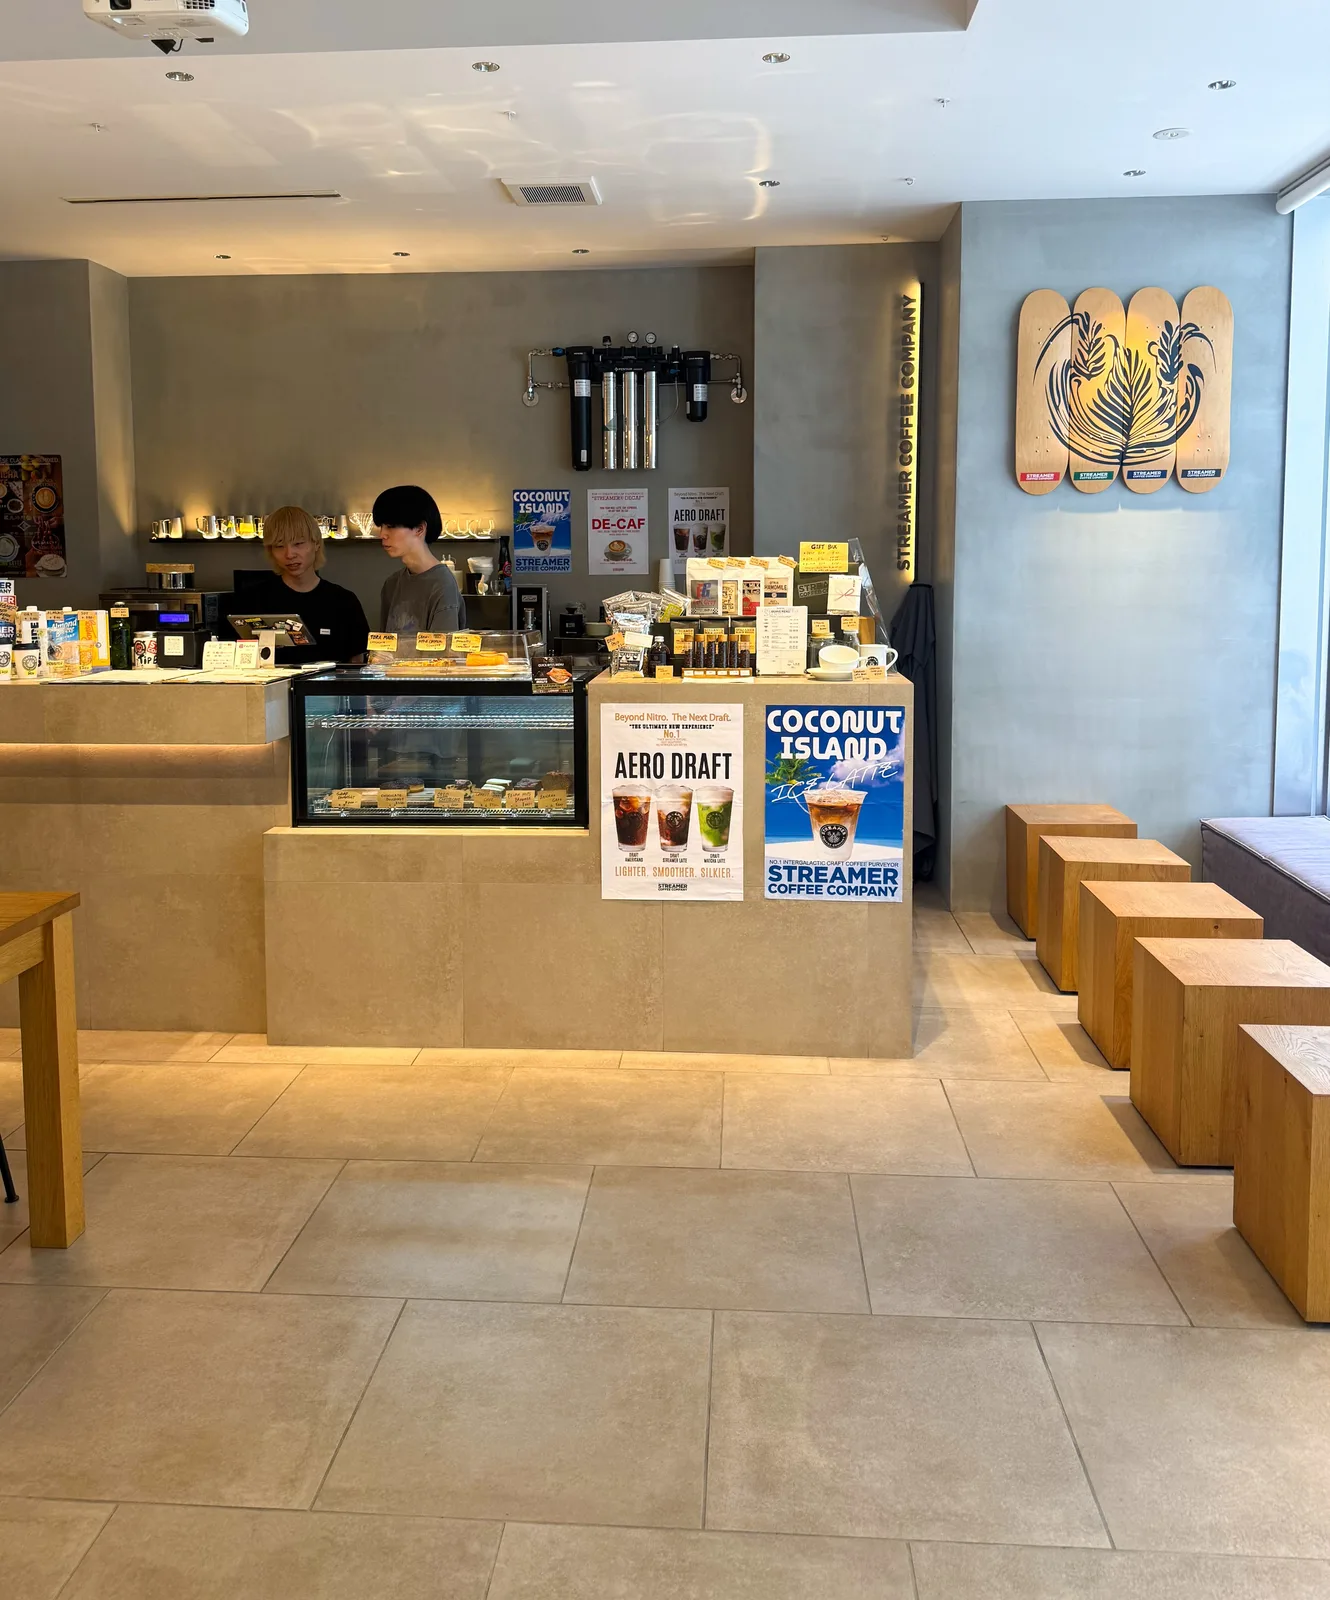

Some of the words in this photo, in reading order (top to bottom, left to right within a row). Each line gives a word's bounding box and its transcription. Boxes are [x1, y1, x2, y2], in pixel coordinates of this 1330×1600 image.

[900, 294, 916, 389] COMPANY
[898, 393, 914, 467] COFFEE
[513, 491, 569, 502] COCONUT
[519, 503, 564, 514] ISLAND
[674, 509, 696, 521] AERO
[699, 508, 725, 521] DRAFT
[592, 518, 646, 530] DE-CAF
[897, 470, 912, 571] STREAMER
[516, 558, 570, 566] STREAMER
[799, 580, 828, 592] STREA
[153, 654, 159, 664] B
[615, 713, 645, 722] Beyond
[646, 713, 668, 721] Nitro.
[672, 713, 687, 721] The
[689, 713, 707, 721] Next
[767, 709, 902, 734] COCONUT
[663, 730, 680, 738] No.1
[781, 736, 888, 761] ISLAND
[615, 752, 664, 779] AERO
[672, 752, 732, 779] DRAFT
[615, 866, 648, 877] LIGHTER.
[653, 867, 697, 878] SMOOTHER.
[701, 867, 734, 878] SILKIER.
[768, 865, 899, 885] STREAMER
[768, 883, 823, 896] COFFEE
[827, 885, 898, 897] COMPANY
